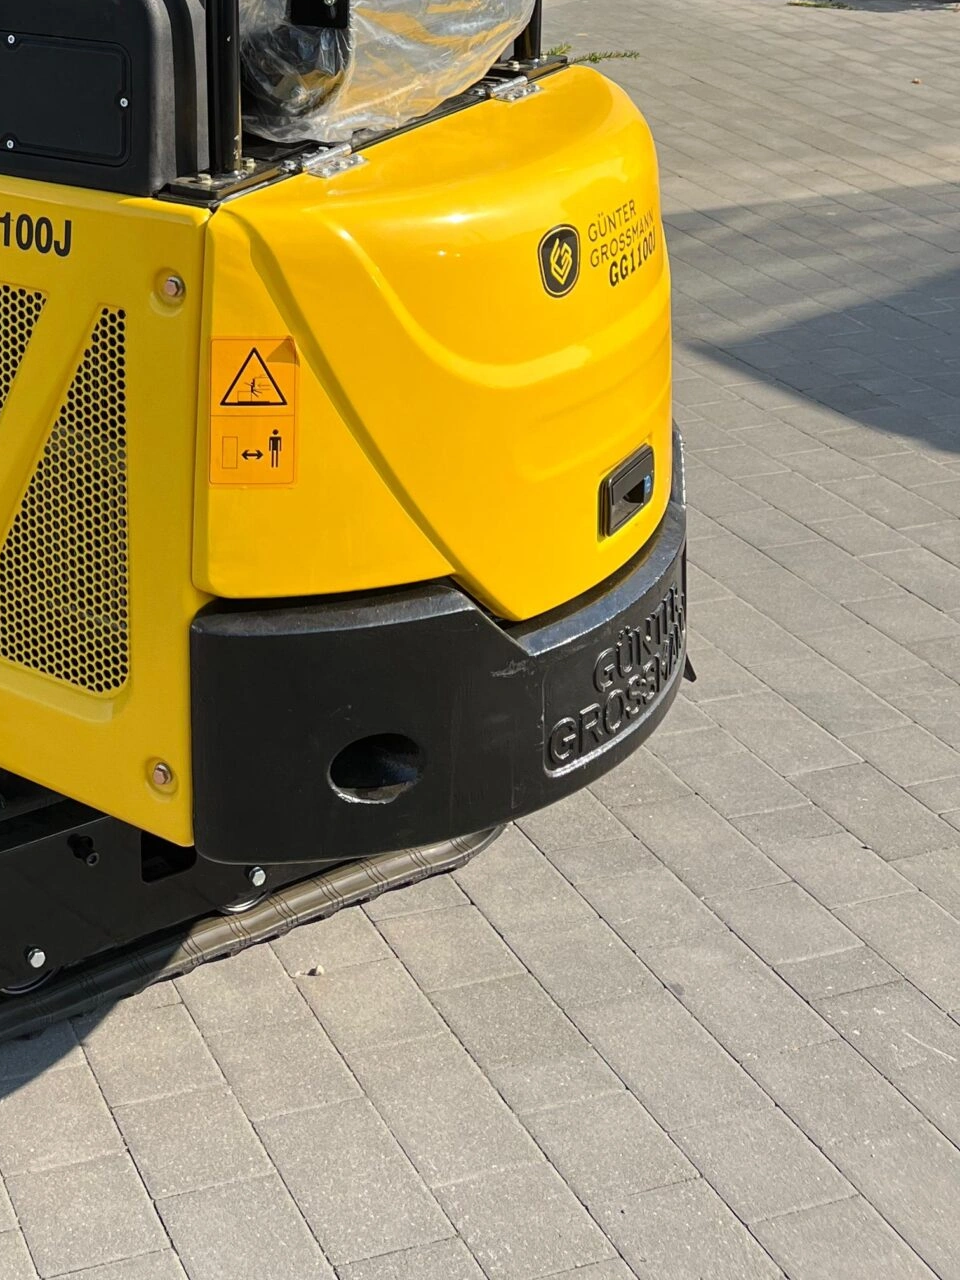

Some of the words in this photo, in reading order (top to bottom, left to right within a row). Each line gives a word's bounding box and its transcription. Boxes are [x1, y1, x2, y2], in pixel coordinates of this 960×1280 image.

[587, 198, 637, 242] GÜNTER
[590, 207, 654, 268] GROSSMANN
[609, 225, 656, 287] GG1100J
